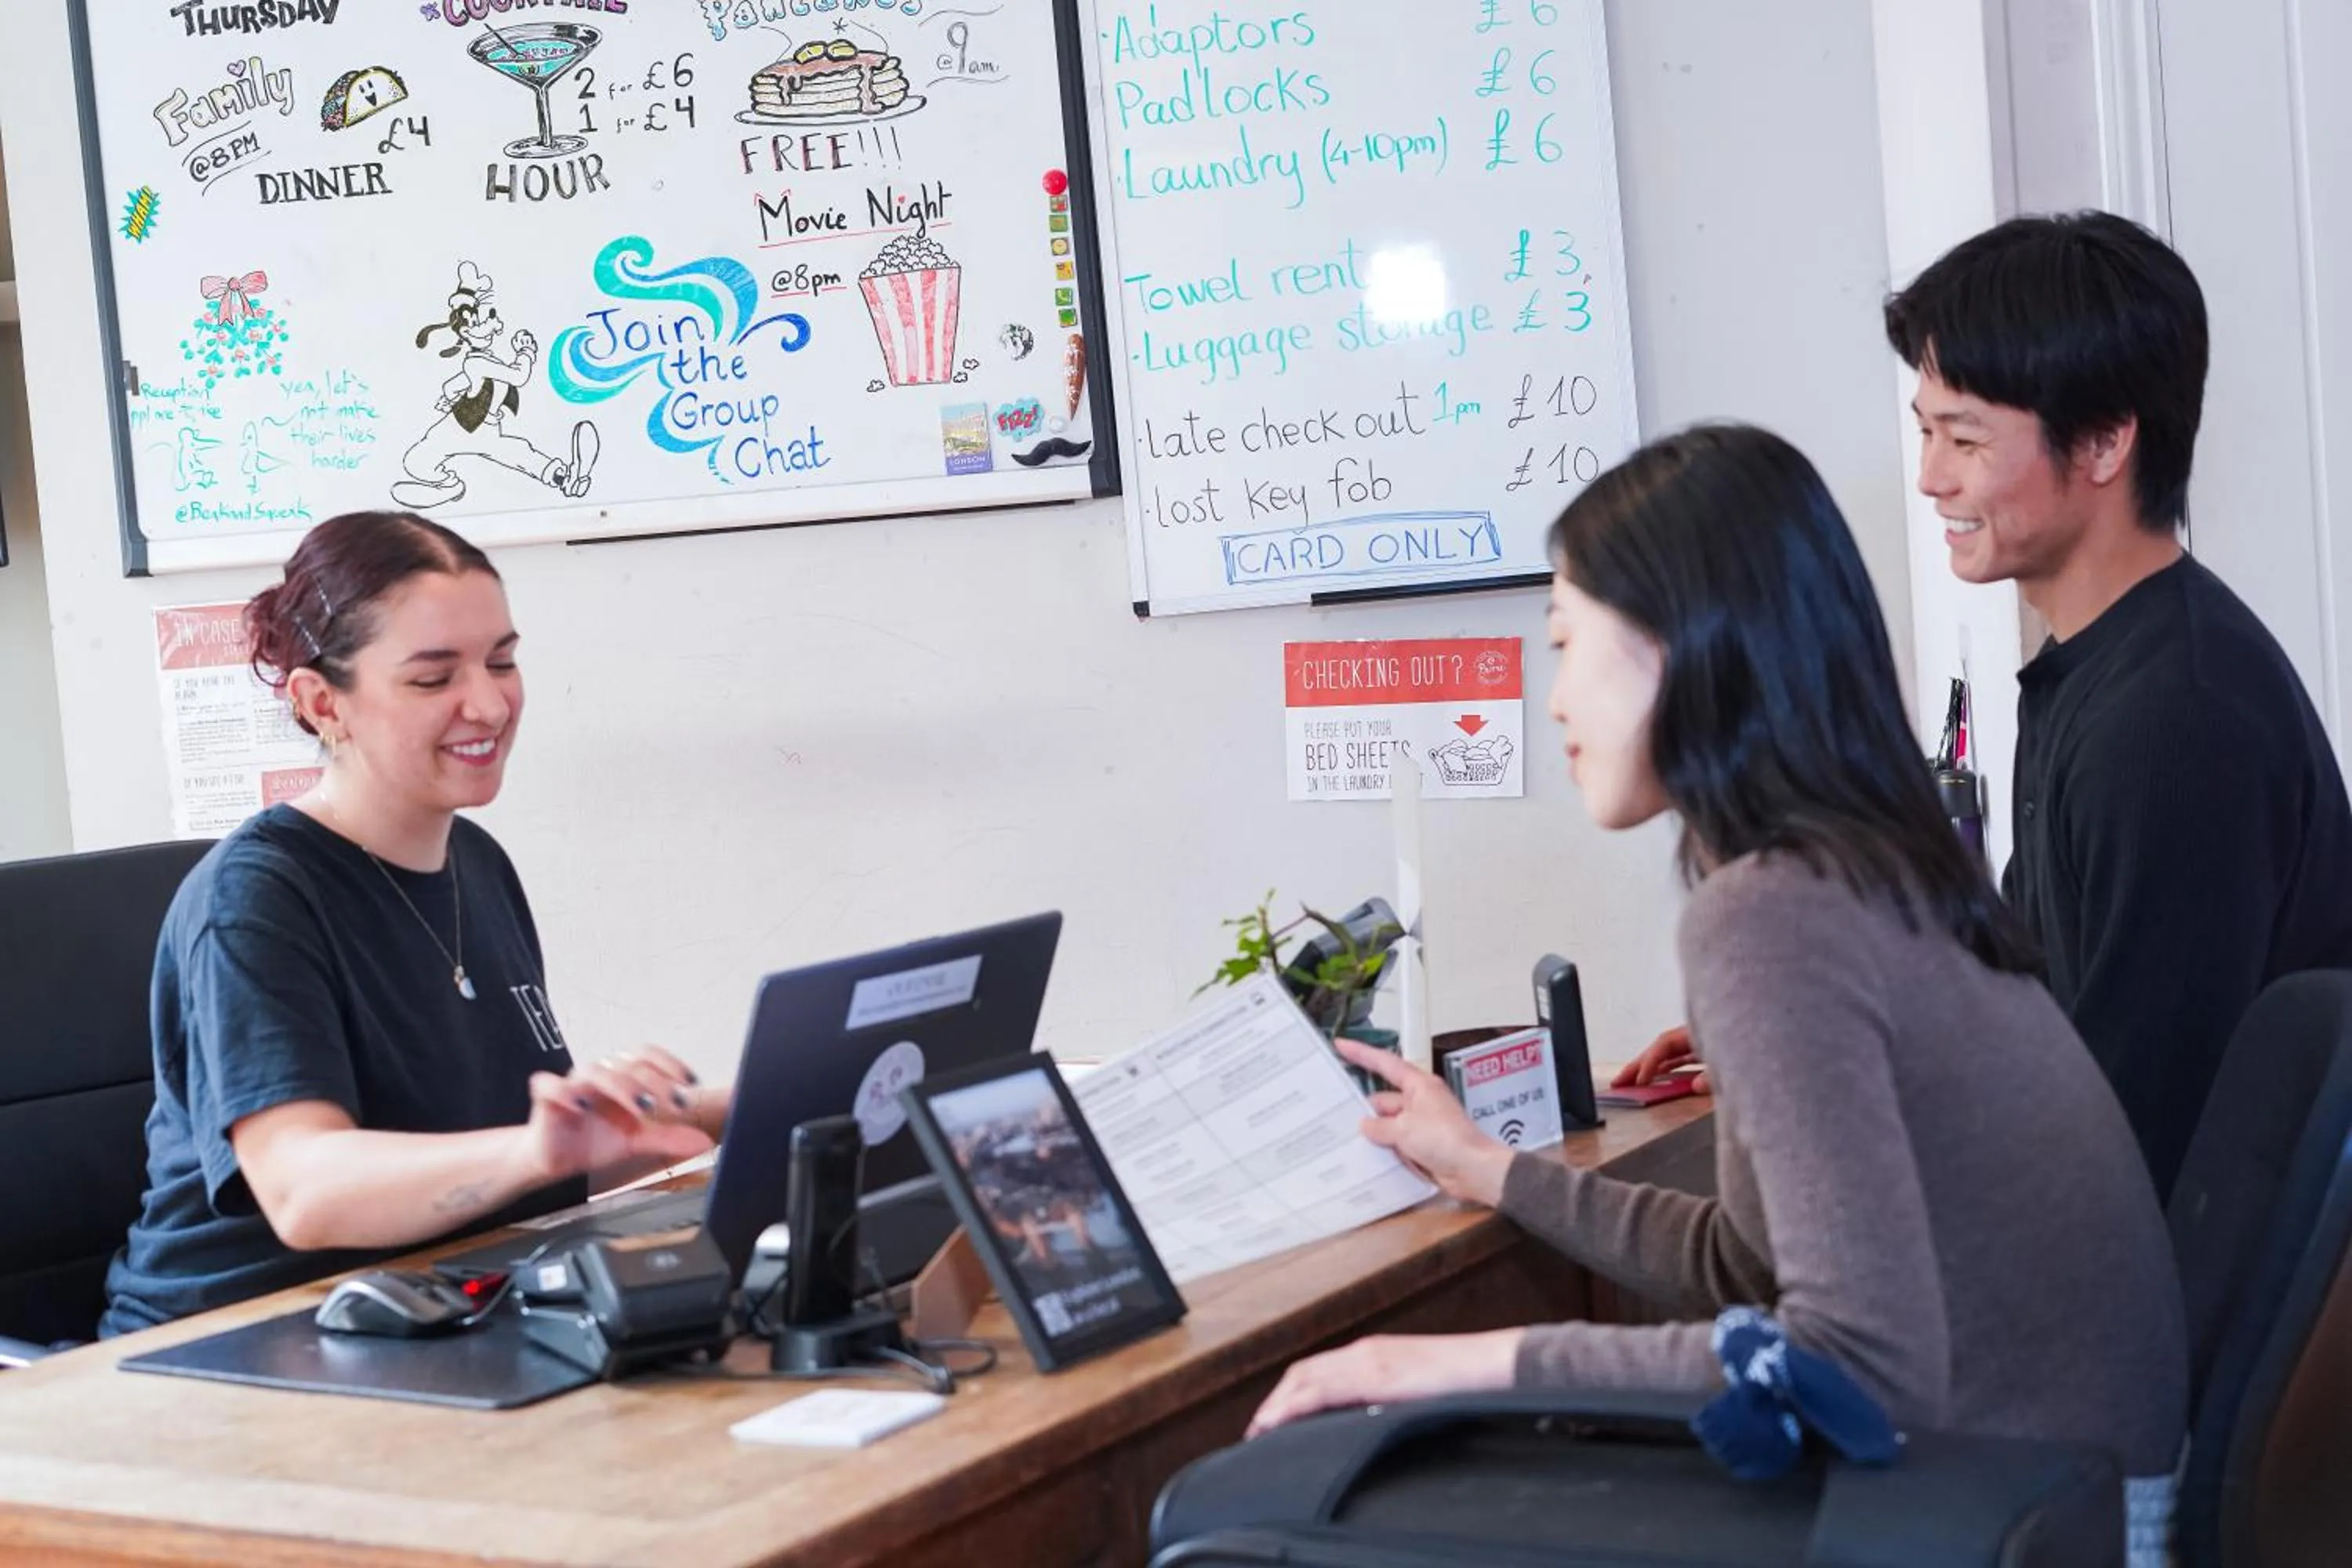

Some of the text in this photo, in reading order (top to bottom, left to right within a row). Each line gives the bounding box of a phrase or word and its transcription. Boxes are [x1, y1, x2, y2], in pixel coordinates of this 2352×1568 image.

[170, 0, 339, 36] THURSDAY
[1115, 4, 1315, 77] Adaptors
[154, 56, 294, 147] Family
[575, 68, 596, 99] 2
[608, 83, 632, 100] for
[378, 117, 430, 154] £4
[579, 103, 597, 132] 1
[616, 118, 635, 133] for
[256, 163, 392, 204] DINNER
[485, 154, 611, 202] HOUR
[1125, 124, 1305, 209] Laundry
[1321, 117, 1447, 183] (4-10pm)
[756, 181, 952, 241] Movie Night
[771, 264, 841, 296] @8pm
[1124, 258, 1253, 313] Towel
[1272, 238, 1368, 296] rent
[585, 308, 704, 360] Join
[1145, 323, 1313, 385] Luggage
[671, 347, 747, 384] the
[290, 422, 376, 446] their lives
[671, 391, 779, 436] Group
[1241, 407, 1345, 452] check
[1355, 380, 1427, 438] out
[1432, 381, 1480, 425] 1pm
[735, 426, 830, 477] Chat
[1156, 478, 1223, 528] lost
[1329, 457, 1392, 508] fob
[1237, 523, 1483, 574] CARD ONLY
[201, 619, 240, 644] CASE
[1303, 658, 1399, 690] CHECKING
[1412, 655, 1463, 687] OUT?
[1305, 720, 1392, 739] PLEASE PUT YOUR
[1305, 742, 1338, 771] BED
[1307, 775, 1318, 792] IN
[1323, 775, 1340, 792] THE
[1344, 774, 1385, 792] LAUNDRY
[1472, 1104, 1496, 1120] CALL
[1497, 1096, 1516, 1112] ONE
[1519, 1091, 1530, 1105] OF
